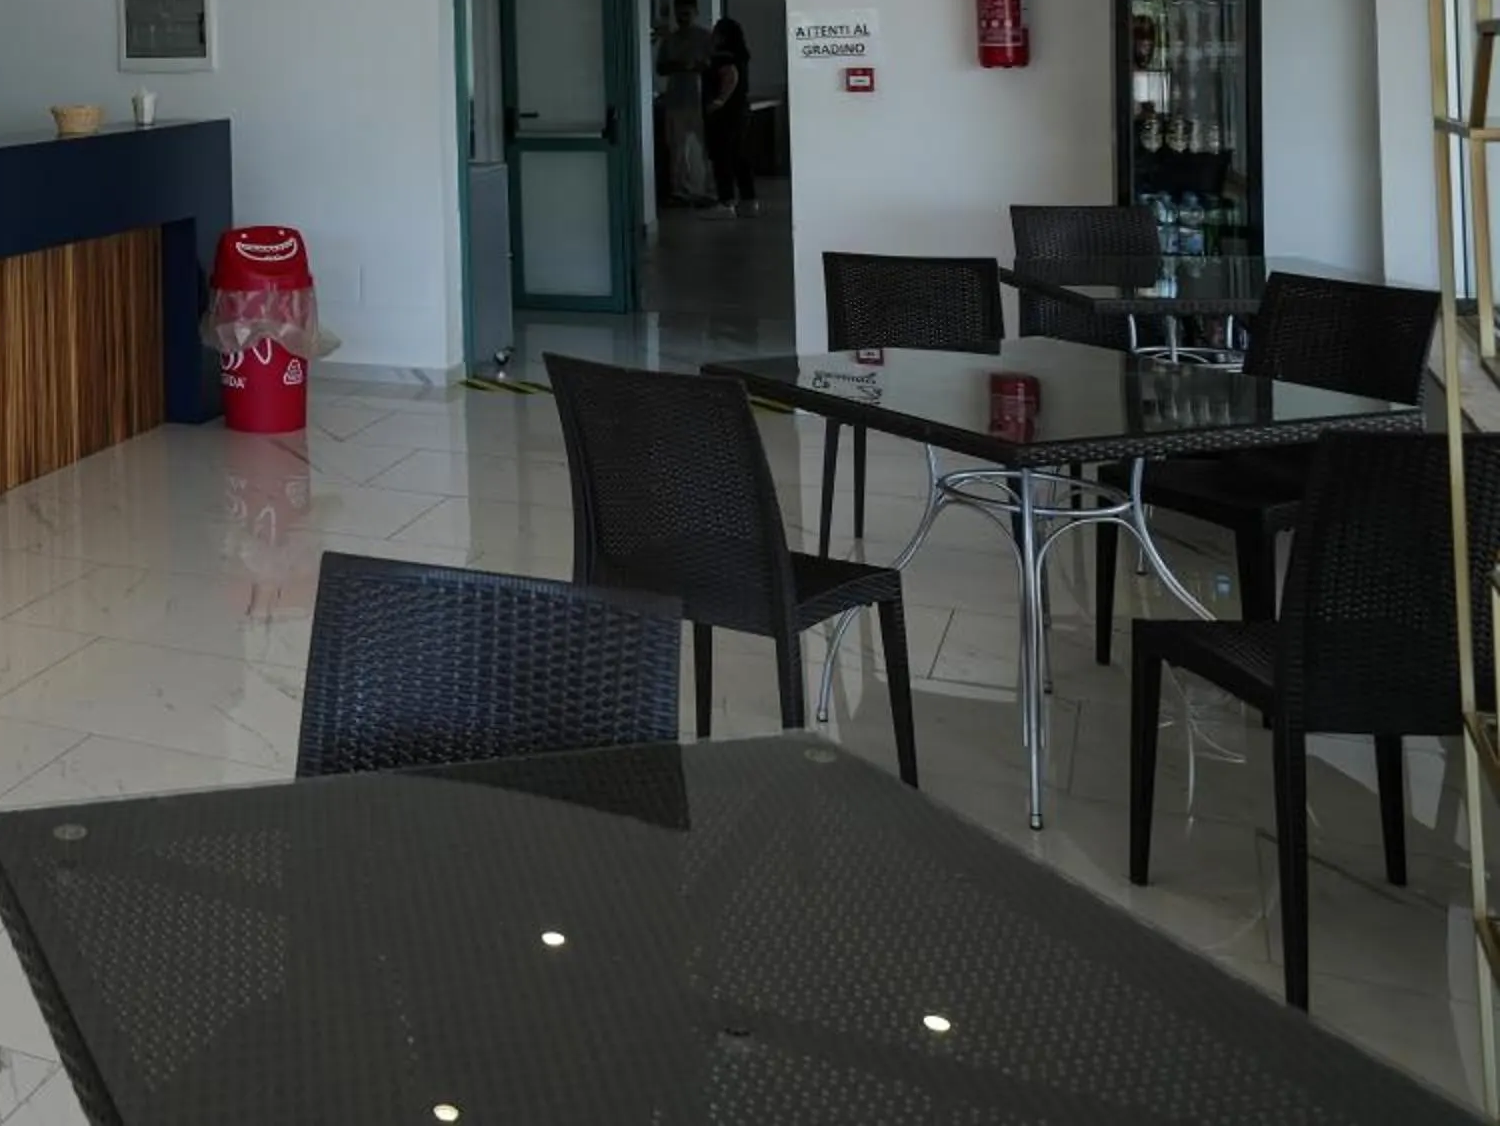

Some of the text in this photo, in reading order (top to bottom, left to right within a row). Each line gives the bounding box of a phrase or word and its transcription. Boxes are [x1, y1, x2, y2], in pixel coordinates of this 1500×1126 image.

[796, 23, 870, 38] ATTENTI AL
[802, 43, 865, 55] GRADINO
